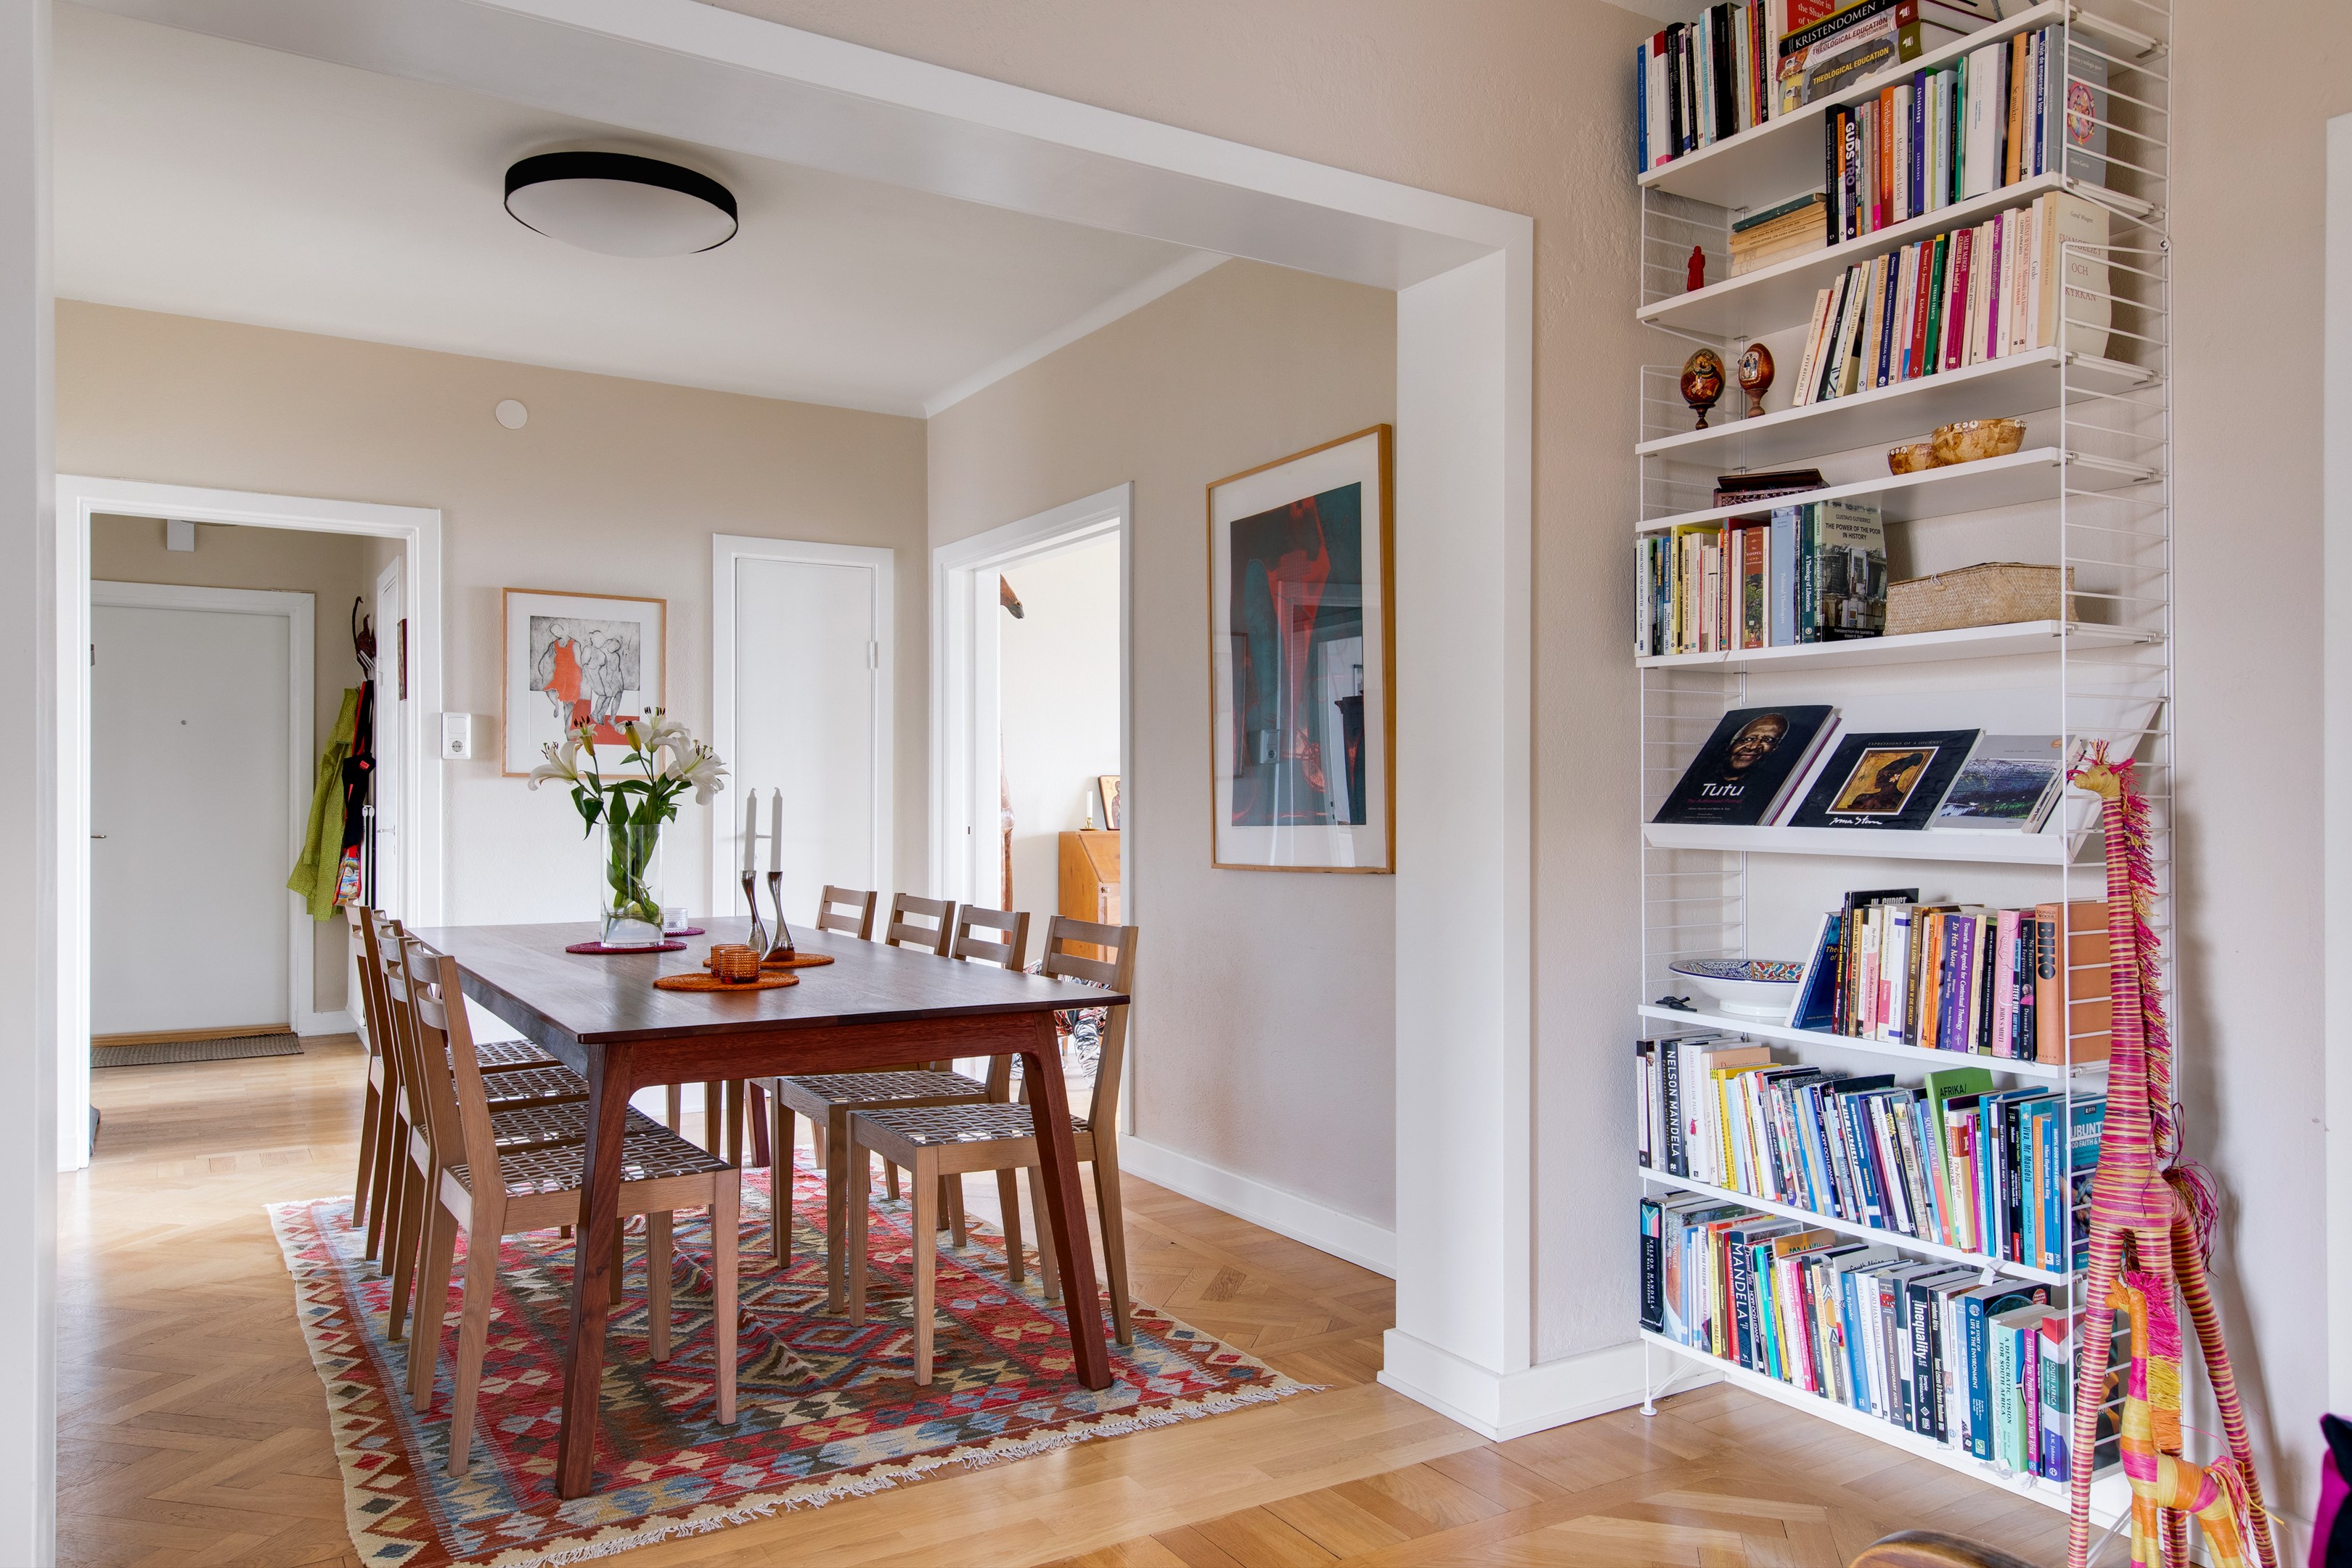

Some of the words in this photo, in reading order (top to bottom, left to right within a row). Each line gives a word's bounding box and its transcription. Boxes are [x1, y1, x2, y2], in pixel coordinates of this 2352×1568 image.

[1795, 1, 1876, 49] KRISTENDOMEN
[1813, 32, 1853, 54] THEOLOGICAL
[1853, 17, 1888, 37] EDUCATION
[1813, 65, 1853, 85] THEOLOGICAL
[1854, 47, 1889, 68] EDUCATION
[2012, 86, 2019, 95] Se
[1845, 123, 1855, 186] GUDSTRO
[2072, 264, 2088, 276] OCH
[1702, 783, 1745, 796] Tutu
[2038, 922, 2055, 980] BIKO
[1956, 1009, 1964, 1031] Theology
[1667, 1051, 1677, 1097] NELSON
[1813, 1090, 1821, 1112] Desmond
[1670, 1101, 1680, 1157] MANDELA
[1924, 1117, 1933, 1138] SOUTH
[2022, 1127, 2030, 1141] Viva,
[1899, 1122, 1908, 1146] ANOTHER
[1904, 1147, 1914, 1172] COUNTRY
[1928, 1139, 1937, 1161] AFRICA
[2024, 1145, 2031, 1153] Mr
[1731, 1243, 1748, 1319] MANDELA
[1913, 1304, 1928, 1360] Inequality
